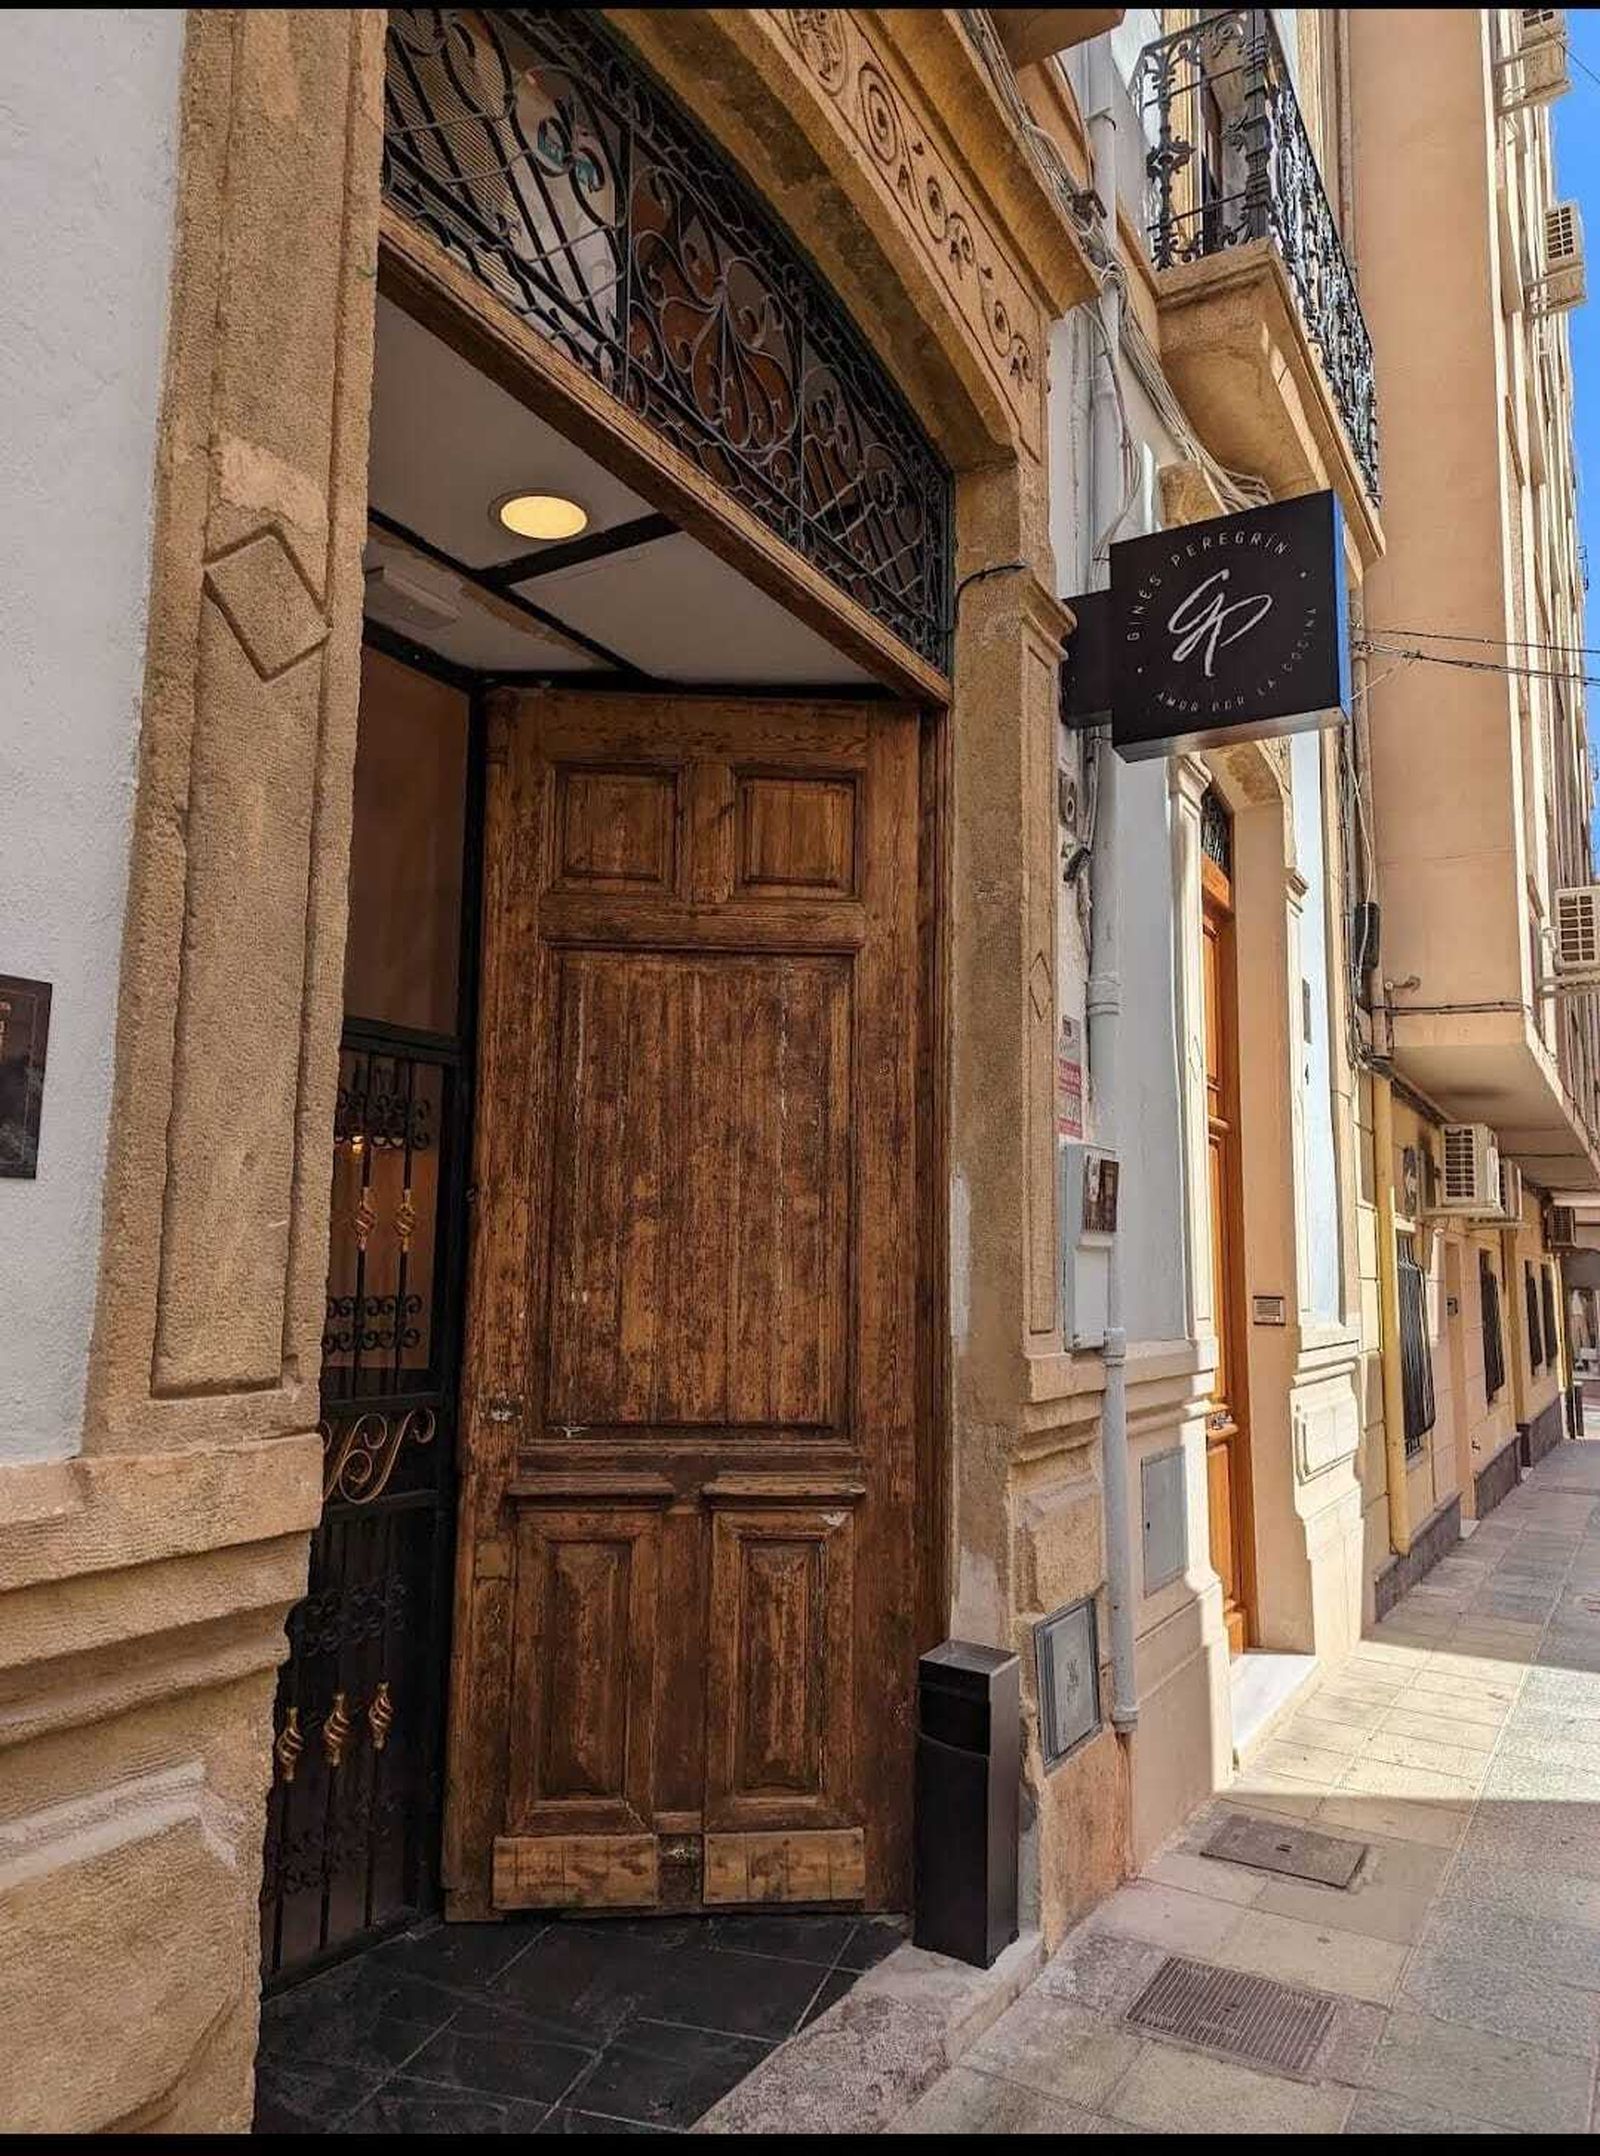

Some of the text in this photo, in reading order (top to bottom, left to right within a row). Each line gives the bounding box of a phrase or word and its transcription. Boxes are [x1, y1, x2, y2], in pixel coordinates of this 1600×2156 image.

[1154, 691, 1198, 712] AMOR
[1211, 696, 1245, 712] POR
[1256, 679, 1277, 697] LA
